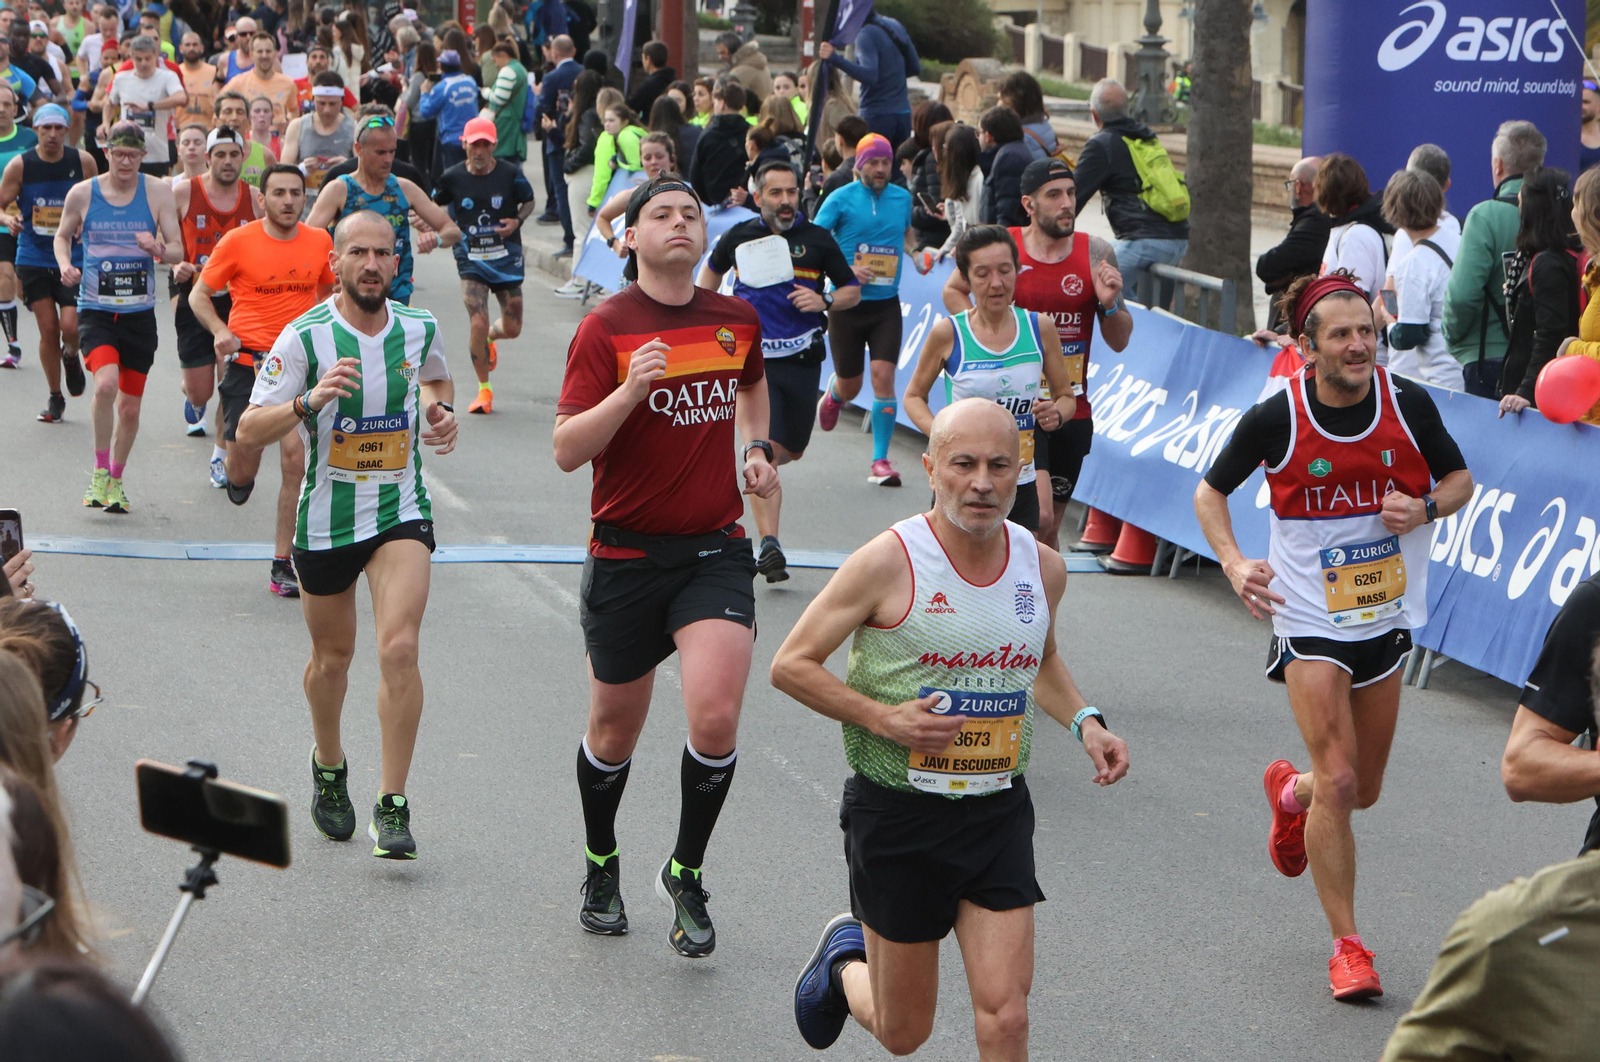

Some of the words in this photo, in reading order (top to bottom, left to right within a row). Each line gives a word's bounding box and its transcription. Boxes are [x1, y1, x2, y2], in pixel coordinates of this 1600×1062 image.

[1445, 16, 1566, 62] asics
[1434, 77, 1482, 92] sound
[1483, 78, 1520, 95] mind,
[1523, 79, 1557, 94] sound
[1558, 80, 1577, 97] body
[91, 221, 148, 230] BARCELONA
[115, 261, 143, 270] ZURICH
[114, 277, 132, 285] 2542
[255, 285, 283, 295] Maadi
[649, 378, 738, 416] QATAR
[672, 404, 735, 427] AIRWAYS
[361, 417, 402, 431] ZURICH
[358, 441, 384, 453] 4961
[356, 459, 383, 469] ISAAC
[1305, 478, 1396, 511] ITALIA
[1351, 541, 1394, 560] ZURICH
[1354, 570, 1383, 587] 6267
[1356, 591, 1387, 606] MASSI
[918, 643, 1038, 670] maratón
[958, 698, 1018, 713] ZURICH
[953, 731, 991, 747] 3673
[919, 755, 950, 770] JAVI
[952, 756, 1012, 771] ESCUDERO
